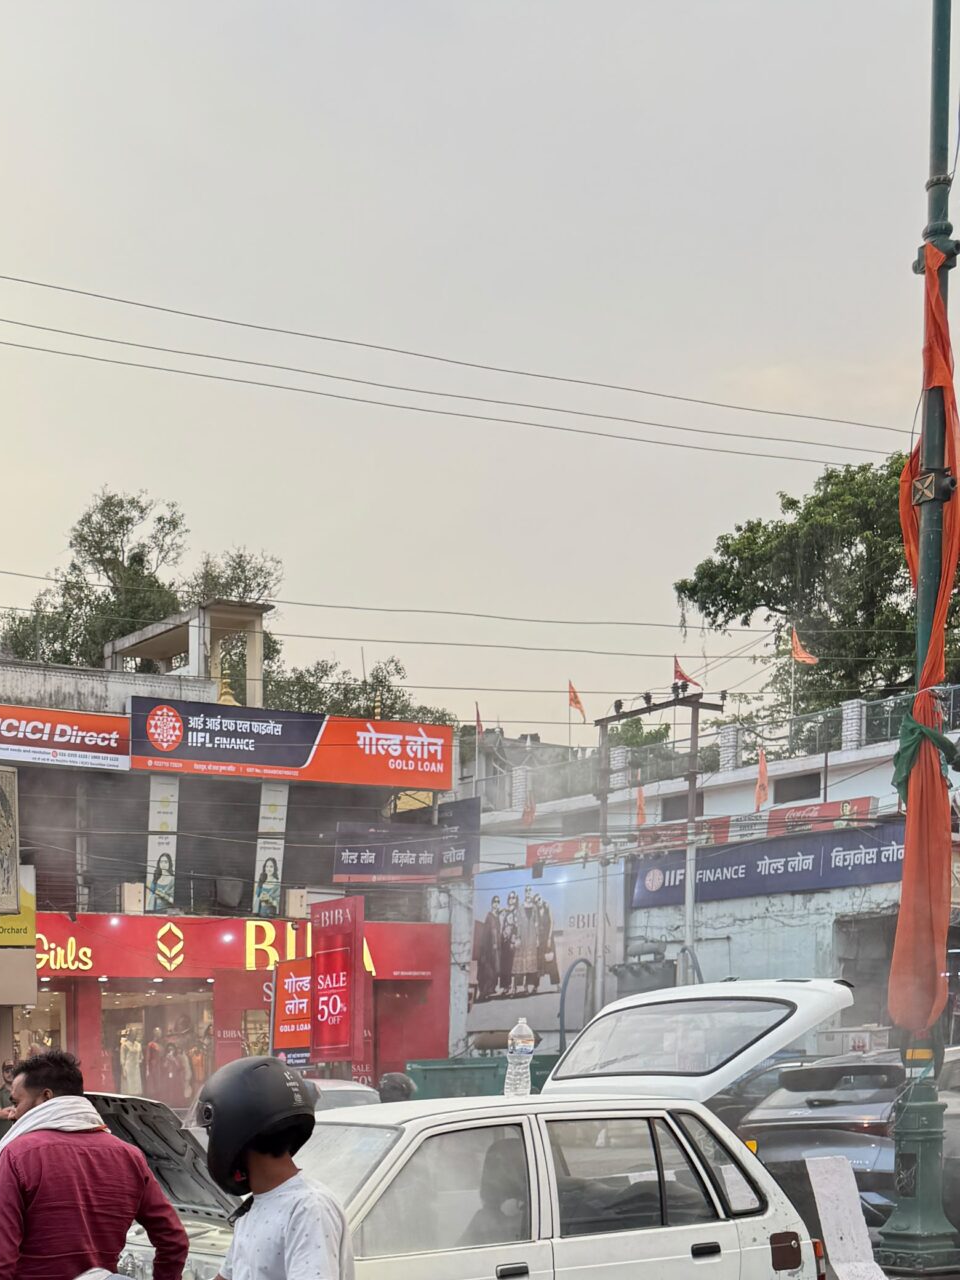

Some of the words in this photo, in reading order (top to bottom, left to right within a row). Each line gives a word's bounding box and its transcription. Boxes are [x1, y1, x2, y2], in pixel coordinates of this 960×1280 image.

[188, 714, 204, 730] आई
[205, 716, 222, 732] आई
[222, 718, 236, 732] एफ
[236, 720, 252, 733] एल
[251, 720, 282, 736] फाइनेंस
[54, 724, 120, 748] Direct
[188, 732, 213, 748] IIFL
[214, 736, 256, 751] FINANCE
[356, 722, 402, 757] गोल्ड
[404, 727, 445, 760] लोन
[388, 758, 415, 770] GOLD
[418, 762, 444, 773] LOAN
[341, 849, 358, 864] गोल्ड
[360, 850, 376, 864] लोन
[418, 850, 434, 864] लोन
[442, 847, 466, 864] लोन
[756, 855, 785, 876] गोल्ड
[788, 852, 814, 872] लोन
[831, 844, 877, 871] बिज़नेस
[664, 871, 685, 886] IIF
[696, 865, 746, 884] FINANCE
[321, 908, 352, 928] BIBA
[284, 972, 311, 993] गोल्ड
[318, 972, 347, 990] SALE
[285, 994, 308, 1016] लोन
[318, 994, 348, 1022] 50%
[280, 1024, 295, 1032] GOLD
[328, 1016, 343, 1026] OFF
